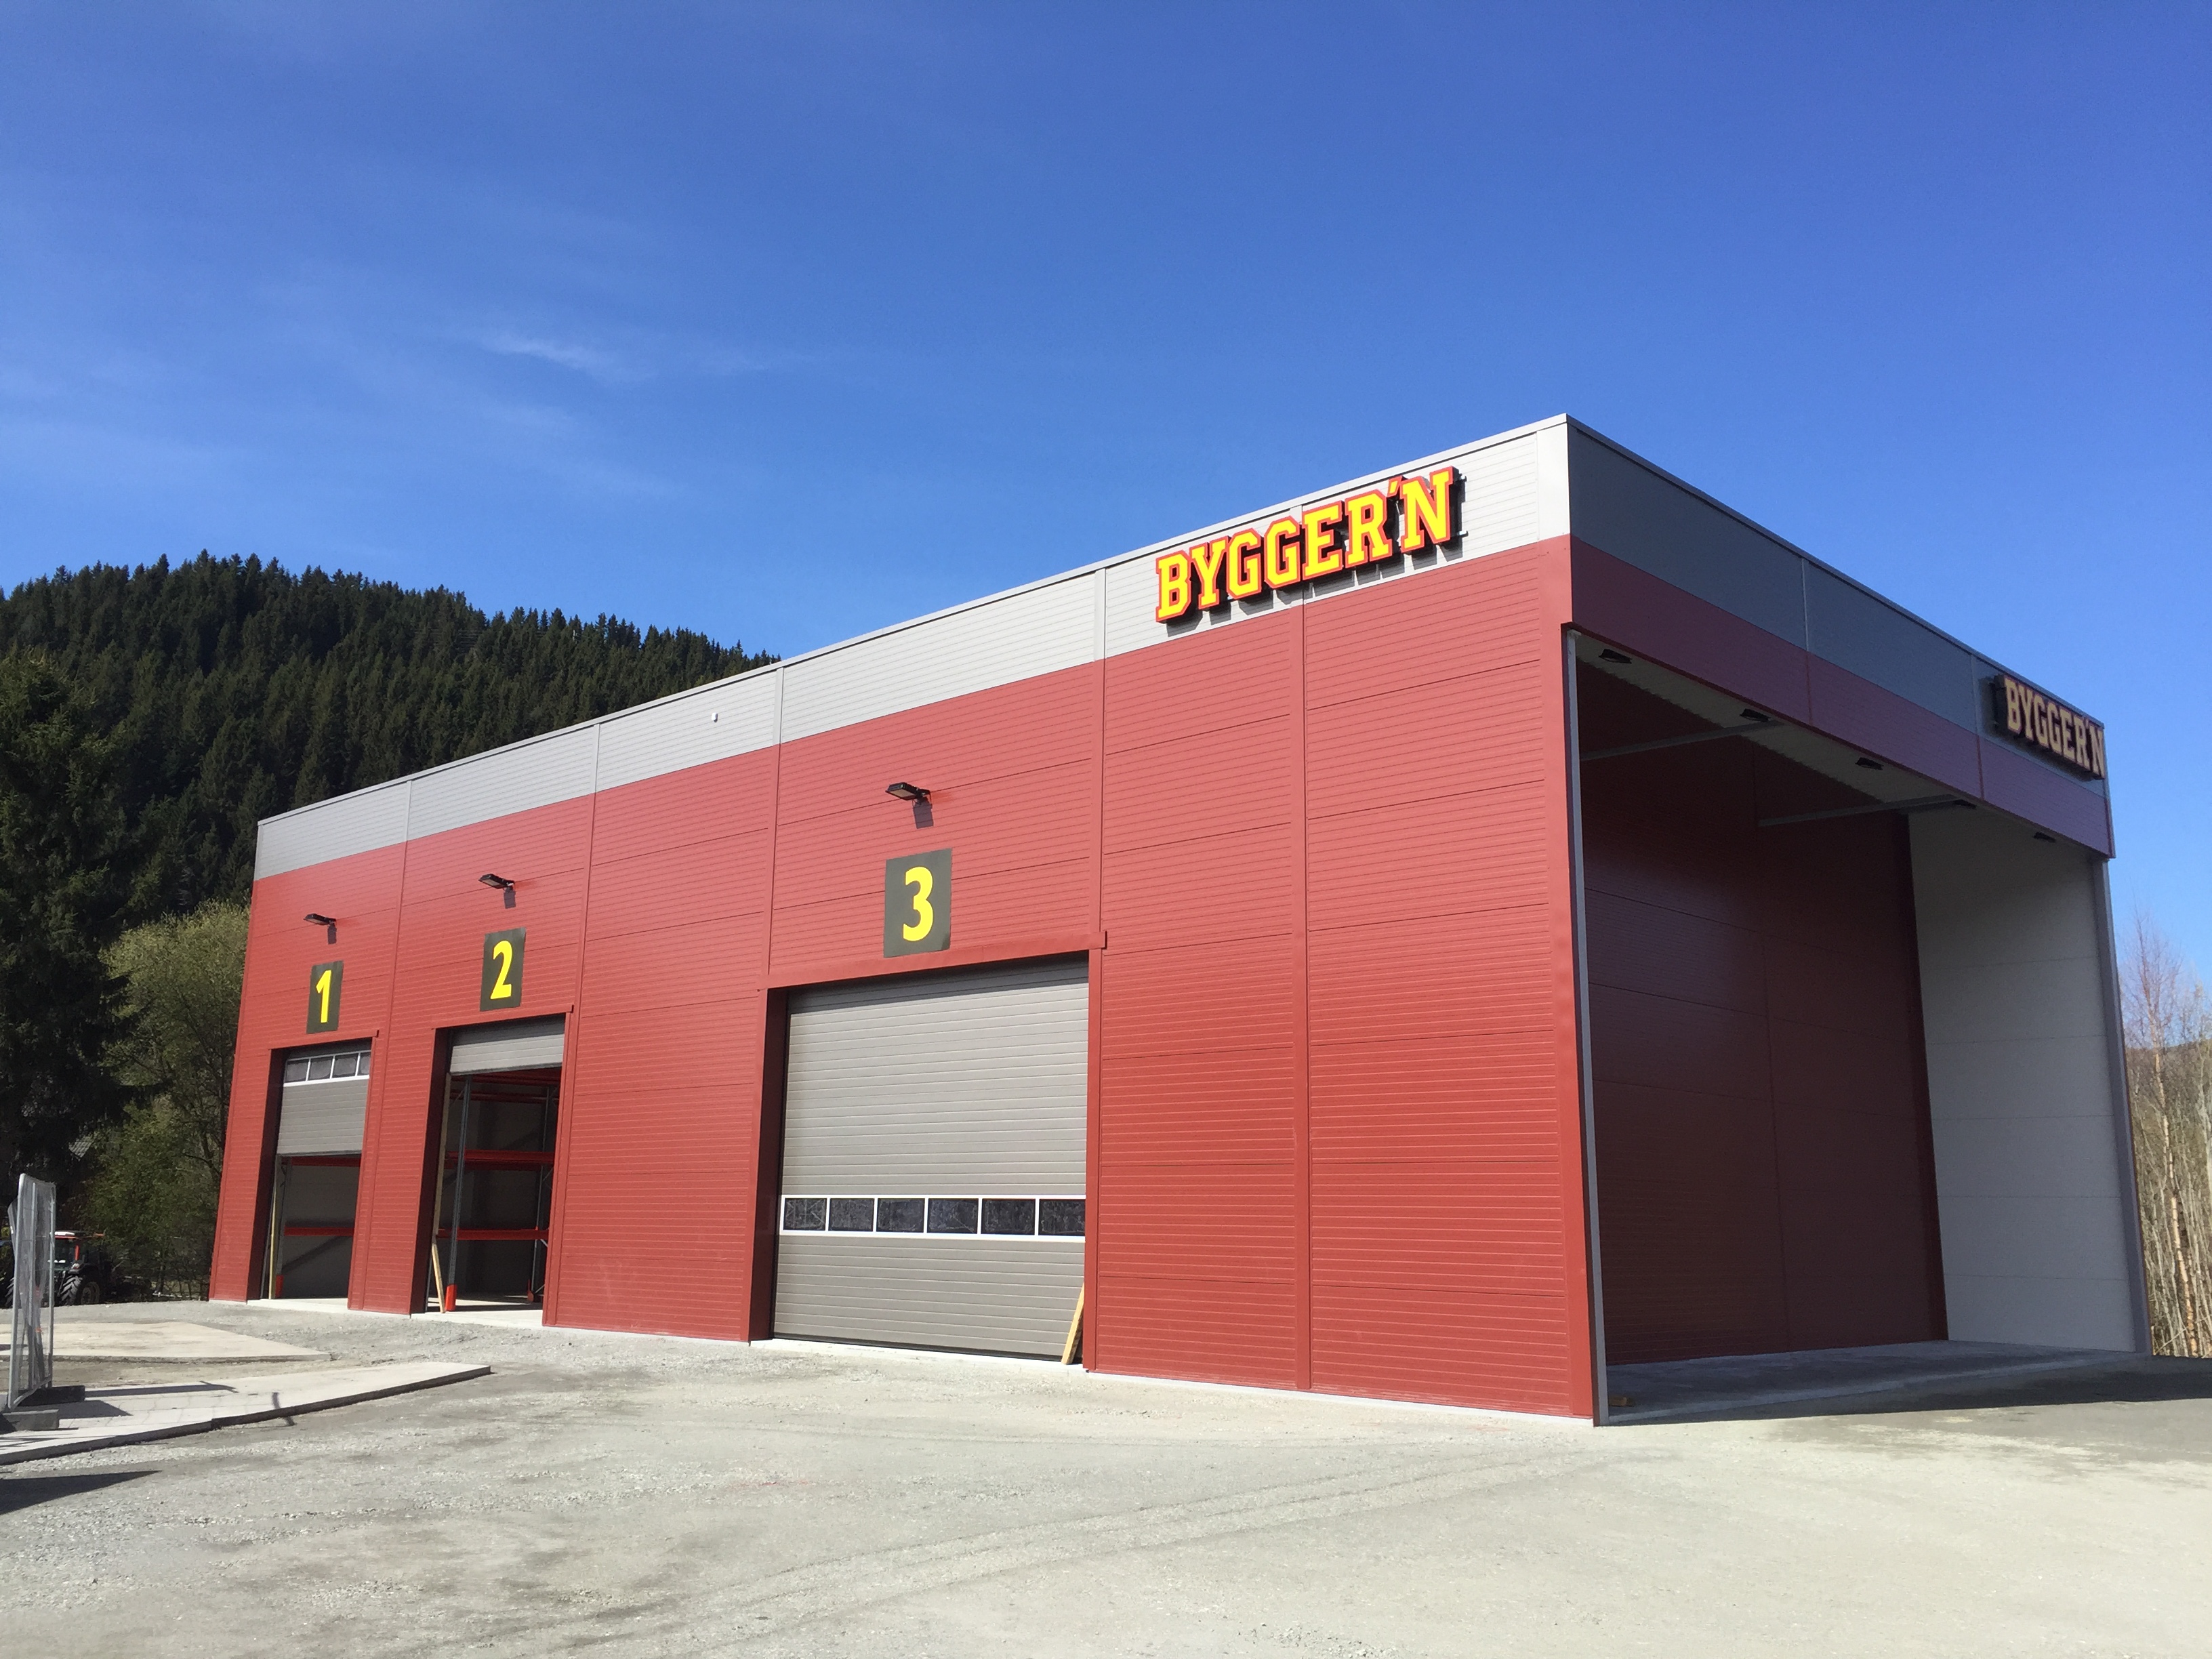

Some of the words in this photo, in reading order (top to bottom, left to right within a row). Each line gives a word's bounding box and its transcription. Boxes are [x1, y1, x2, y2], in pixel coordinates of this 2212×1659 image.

[903, 866, 934, 941] 3
[316, 970, 332, 1023] 1
[490, 940, 513, 1000] 2
